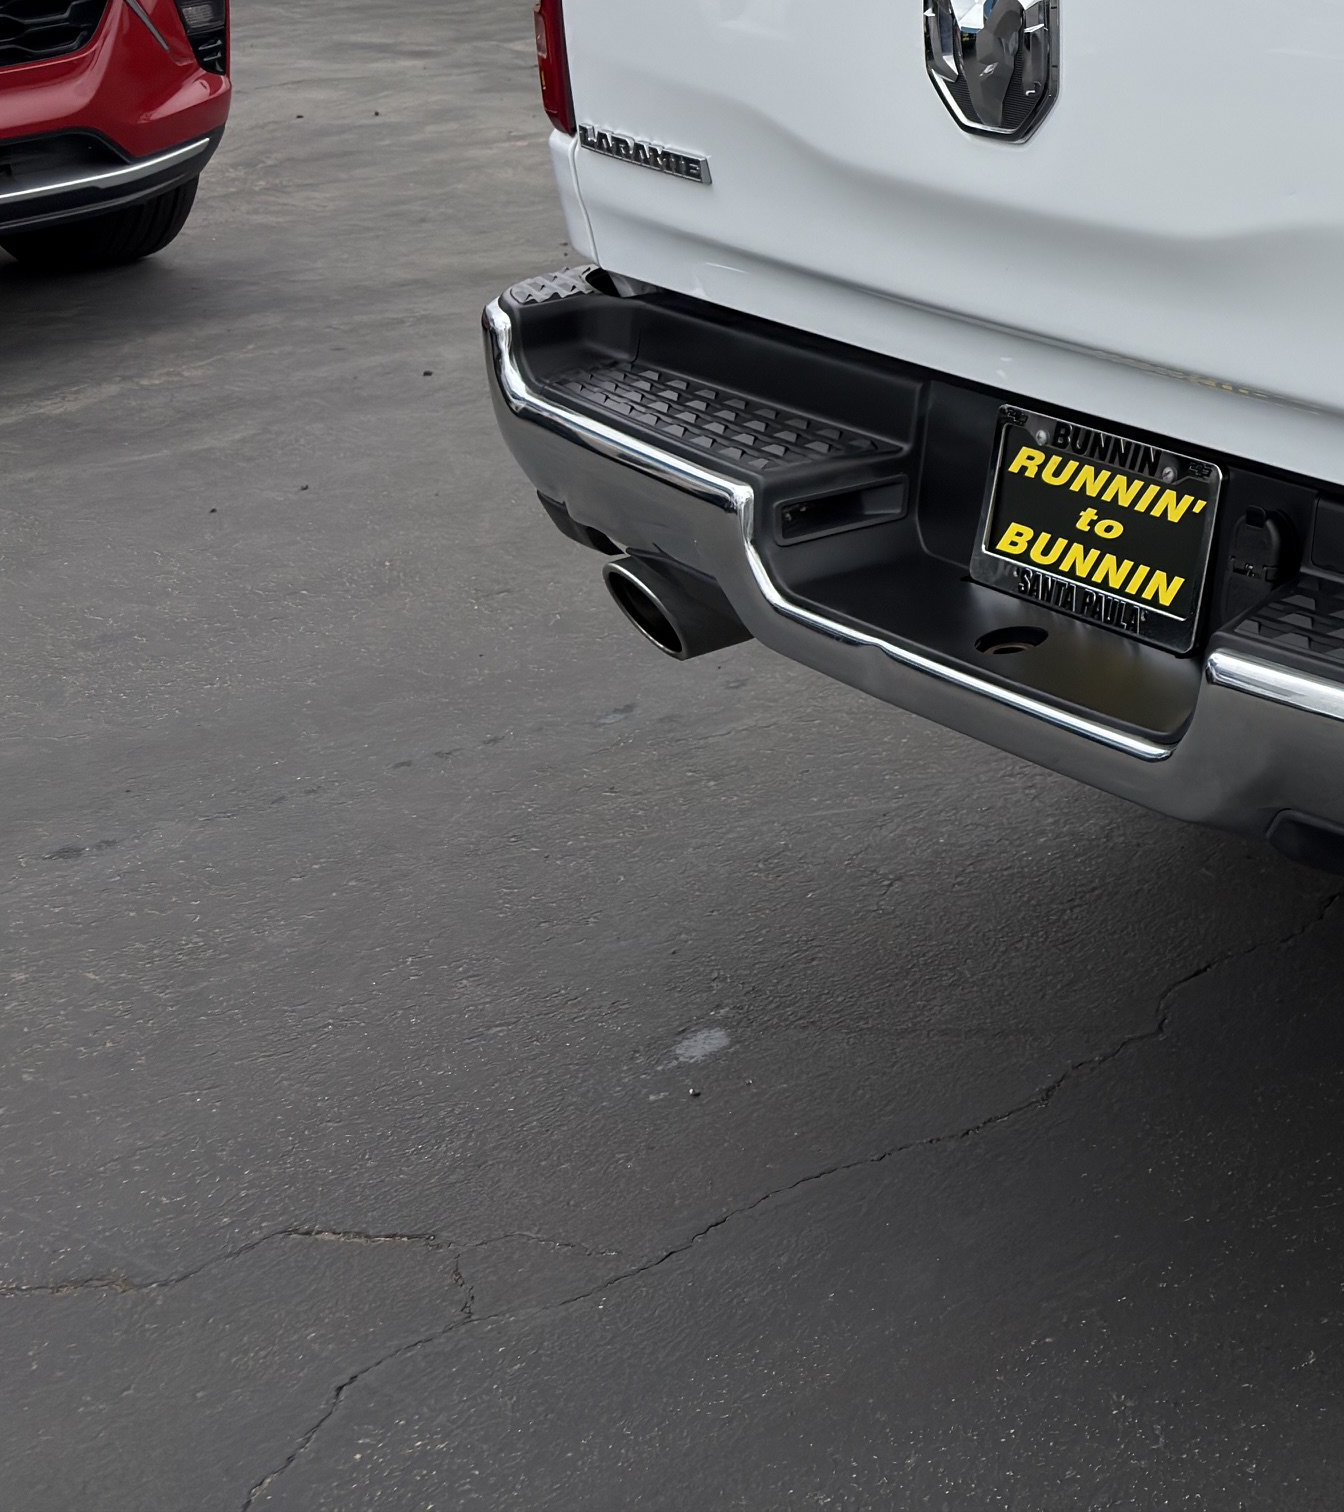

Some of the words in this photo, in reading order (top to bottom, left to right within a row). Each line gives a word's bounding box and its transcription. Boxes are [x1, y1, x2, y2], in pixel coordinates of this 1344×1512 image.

[1052, 420, 1162, 478] BUNNIN
[1007, 445, 1207, 524] RUNNIN'
[1075, 506, 1125, 540] to
[995, 521, 1186, 607] BUNNIN
[1017, 566, 1077, 614] SANTA
[1081, 587, 1142, 636] PAULA
